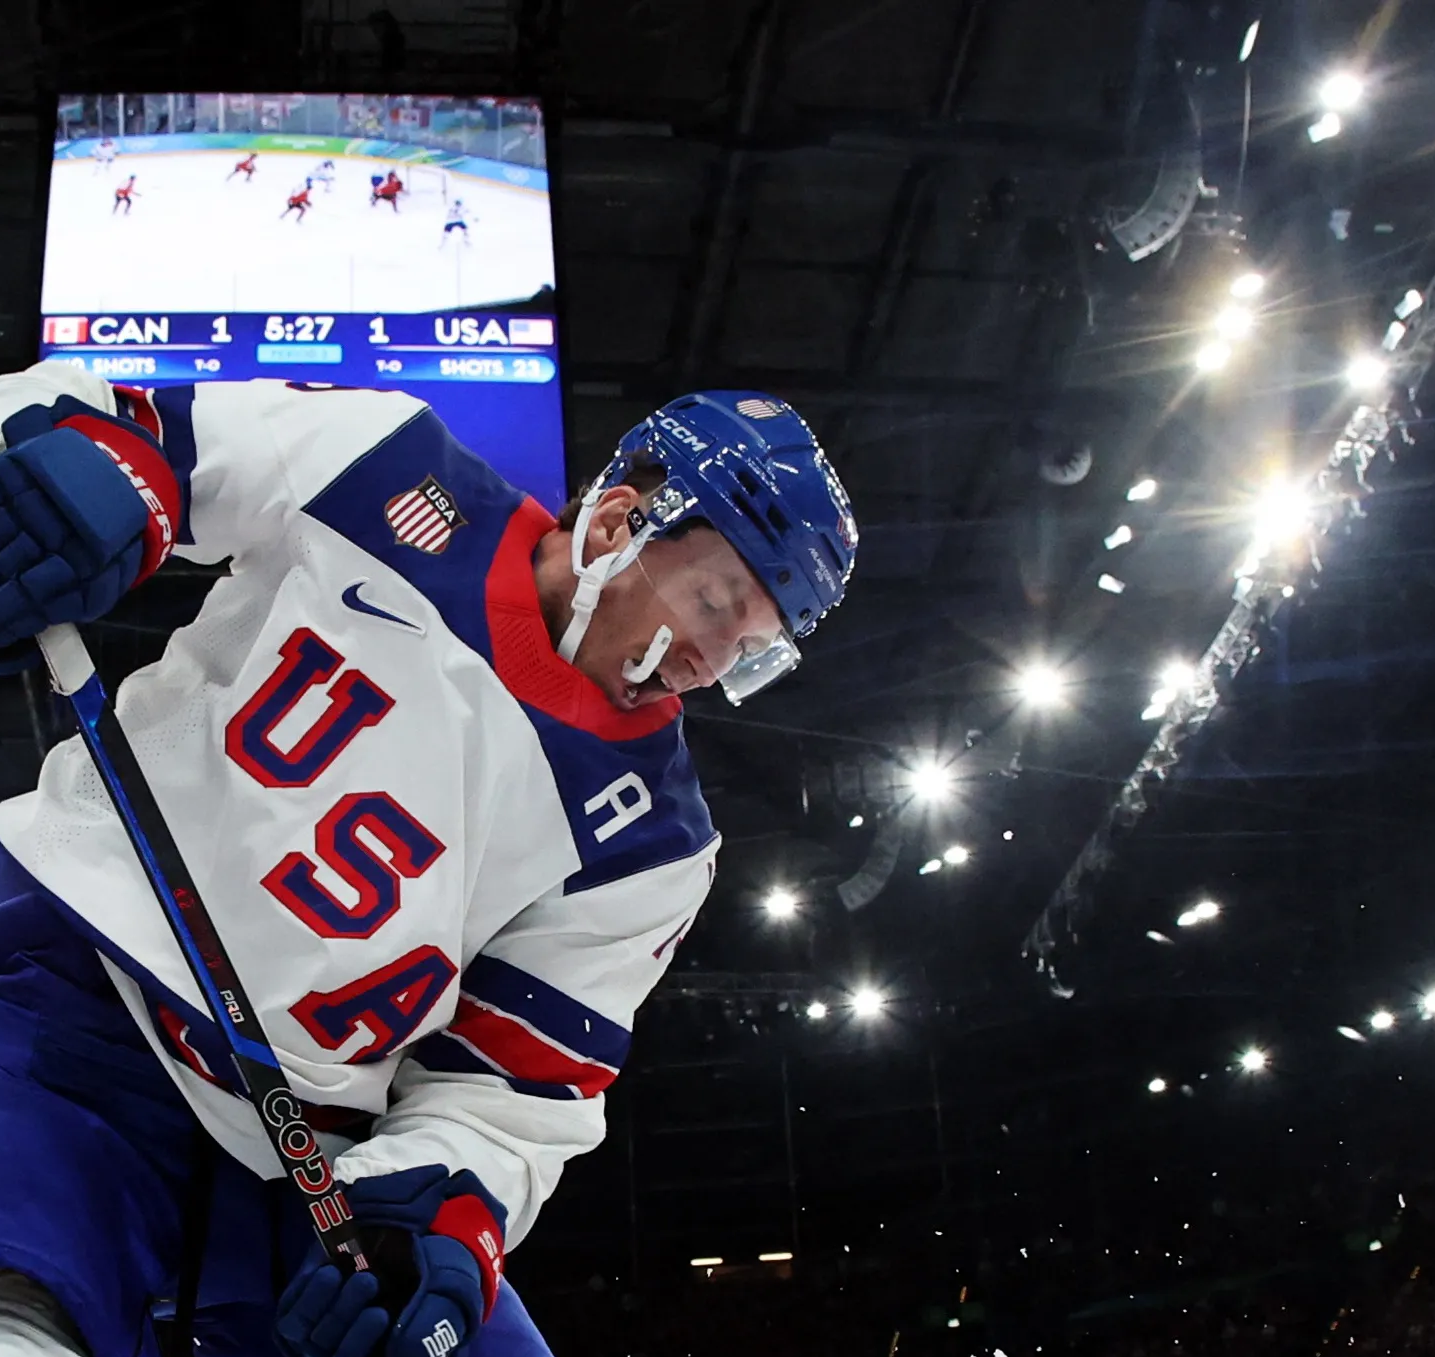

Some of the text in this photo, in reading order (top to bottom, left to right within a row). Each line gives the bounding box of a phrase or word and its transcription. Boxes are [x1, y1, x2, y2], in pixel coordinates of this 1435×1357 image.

[90, 316, 509, 346] CAN 1 5:27 1 USA
[91, 357, 157, 375] SHOTS
[439, 359, 504, 377] SHOTS
[661, 415, 709, 453] CCM
[424, 484, 457, 525] USA
[583, 770, 653, 845] A
[224, 626, 459, 1065] USA
[220, 989, 246, 1025] PRO
[263, 1087, 353, 1233] CODE
